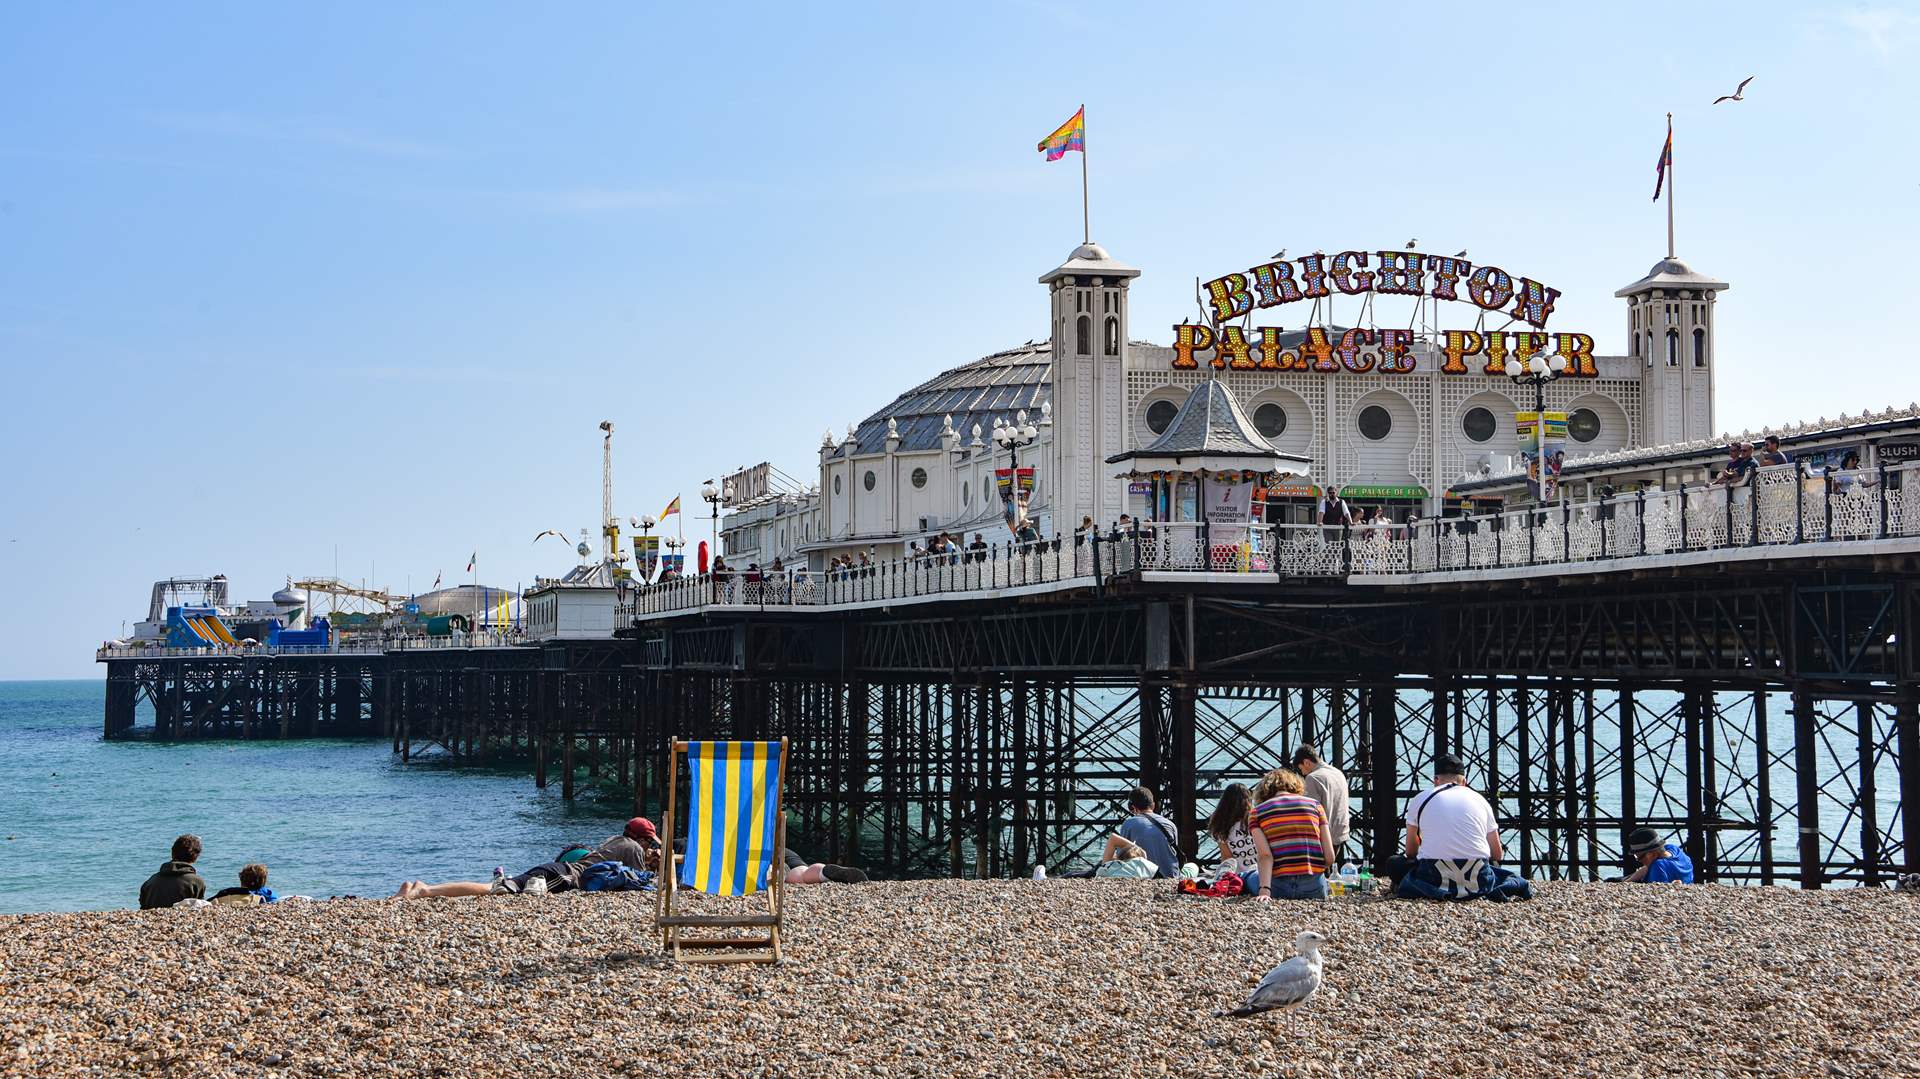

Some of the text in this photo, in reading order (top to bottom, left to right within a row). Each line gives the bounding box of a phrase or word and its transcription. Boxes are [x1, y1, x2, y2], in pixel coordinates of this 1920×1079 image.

[1202, 251, 1562, 329] BRIGHTON
[1172, 324, 1599, 378] PALACE PIER
[1880, 446, 1917, 457] SLUSH
[1344, 487, 1358, 496] THE
[1361, 487, 1390, 496] PALACE
[1394, 488, 1403, 496] OF
[1229, 837, 1254, 849] SOCI
[1232, 846, 1257, 859] SOCI
[1434, 858, 1485, 899] NY
